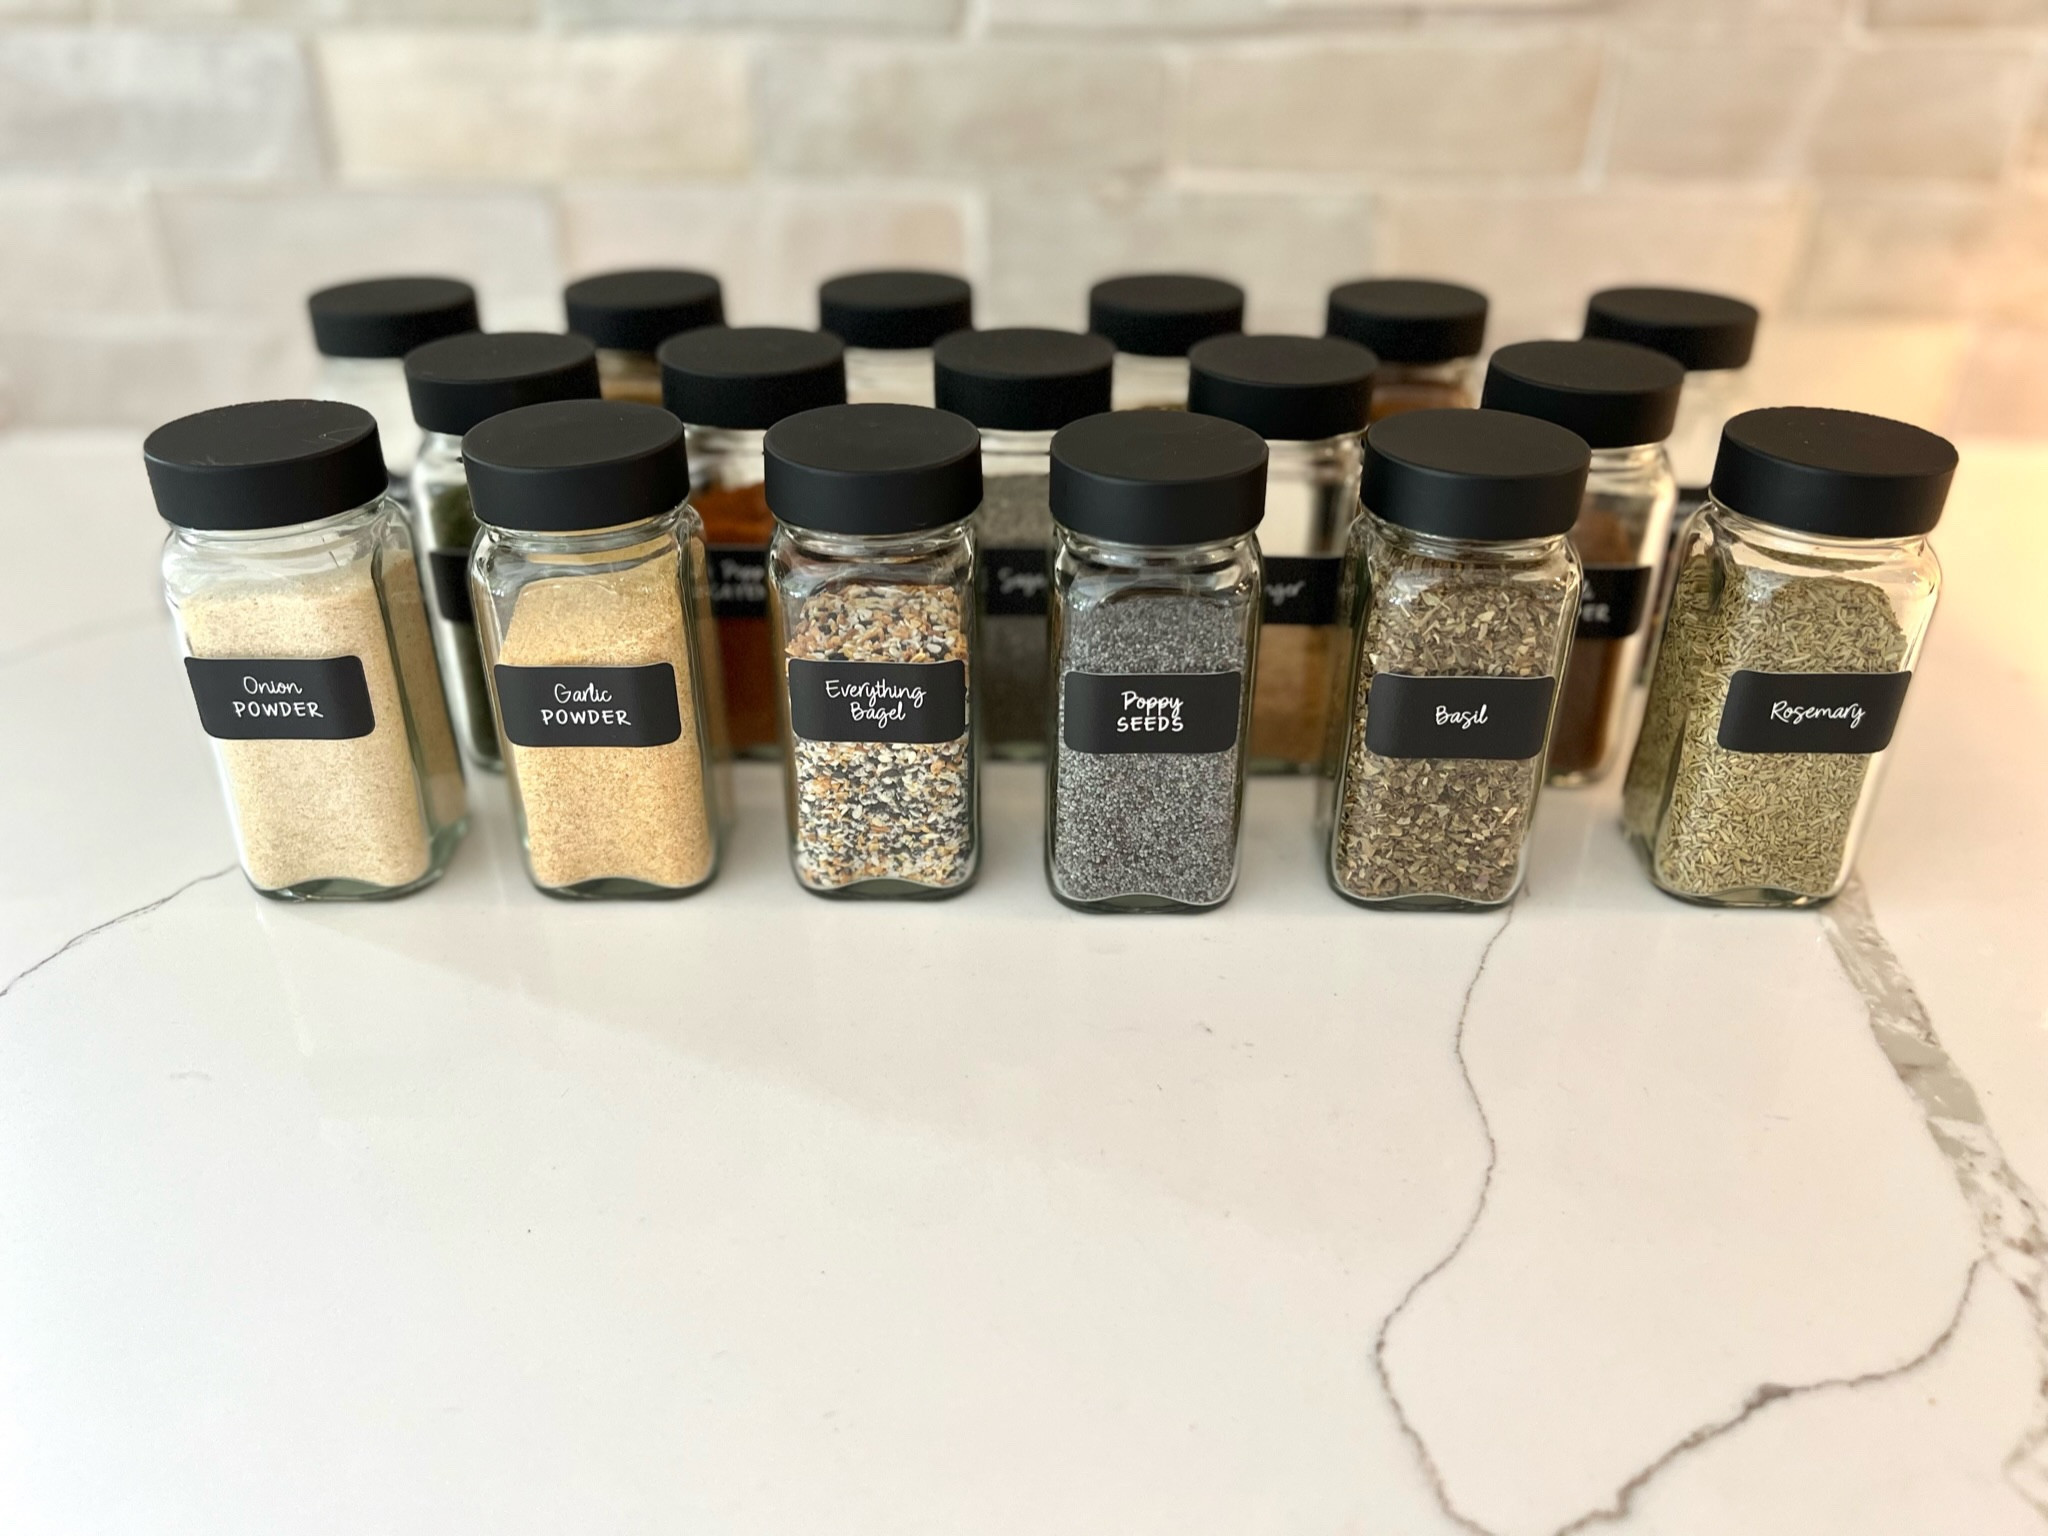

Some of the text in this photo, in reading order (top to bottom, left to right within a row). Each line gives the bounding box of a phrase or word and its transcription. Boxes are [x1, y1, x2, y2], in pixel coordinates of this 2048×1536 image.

[243, 675, 303, 695] Onion
[554, 682, 613, 704] Garlic
[825, 678, 927, 709] Everything
[232, 701, 324, 718] POWDER
[850, 700, 907, 729] Bagel
[1120, 690, 1184, 719] Poppy
[1435, 703, 1489, 730] Basil
[1770, 700, 1867, 729] Rosemary
[540, 708, 632, 726] POWDER
[1116, 716, 1184, 732] SEEDS
